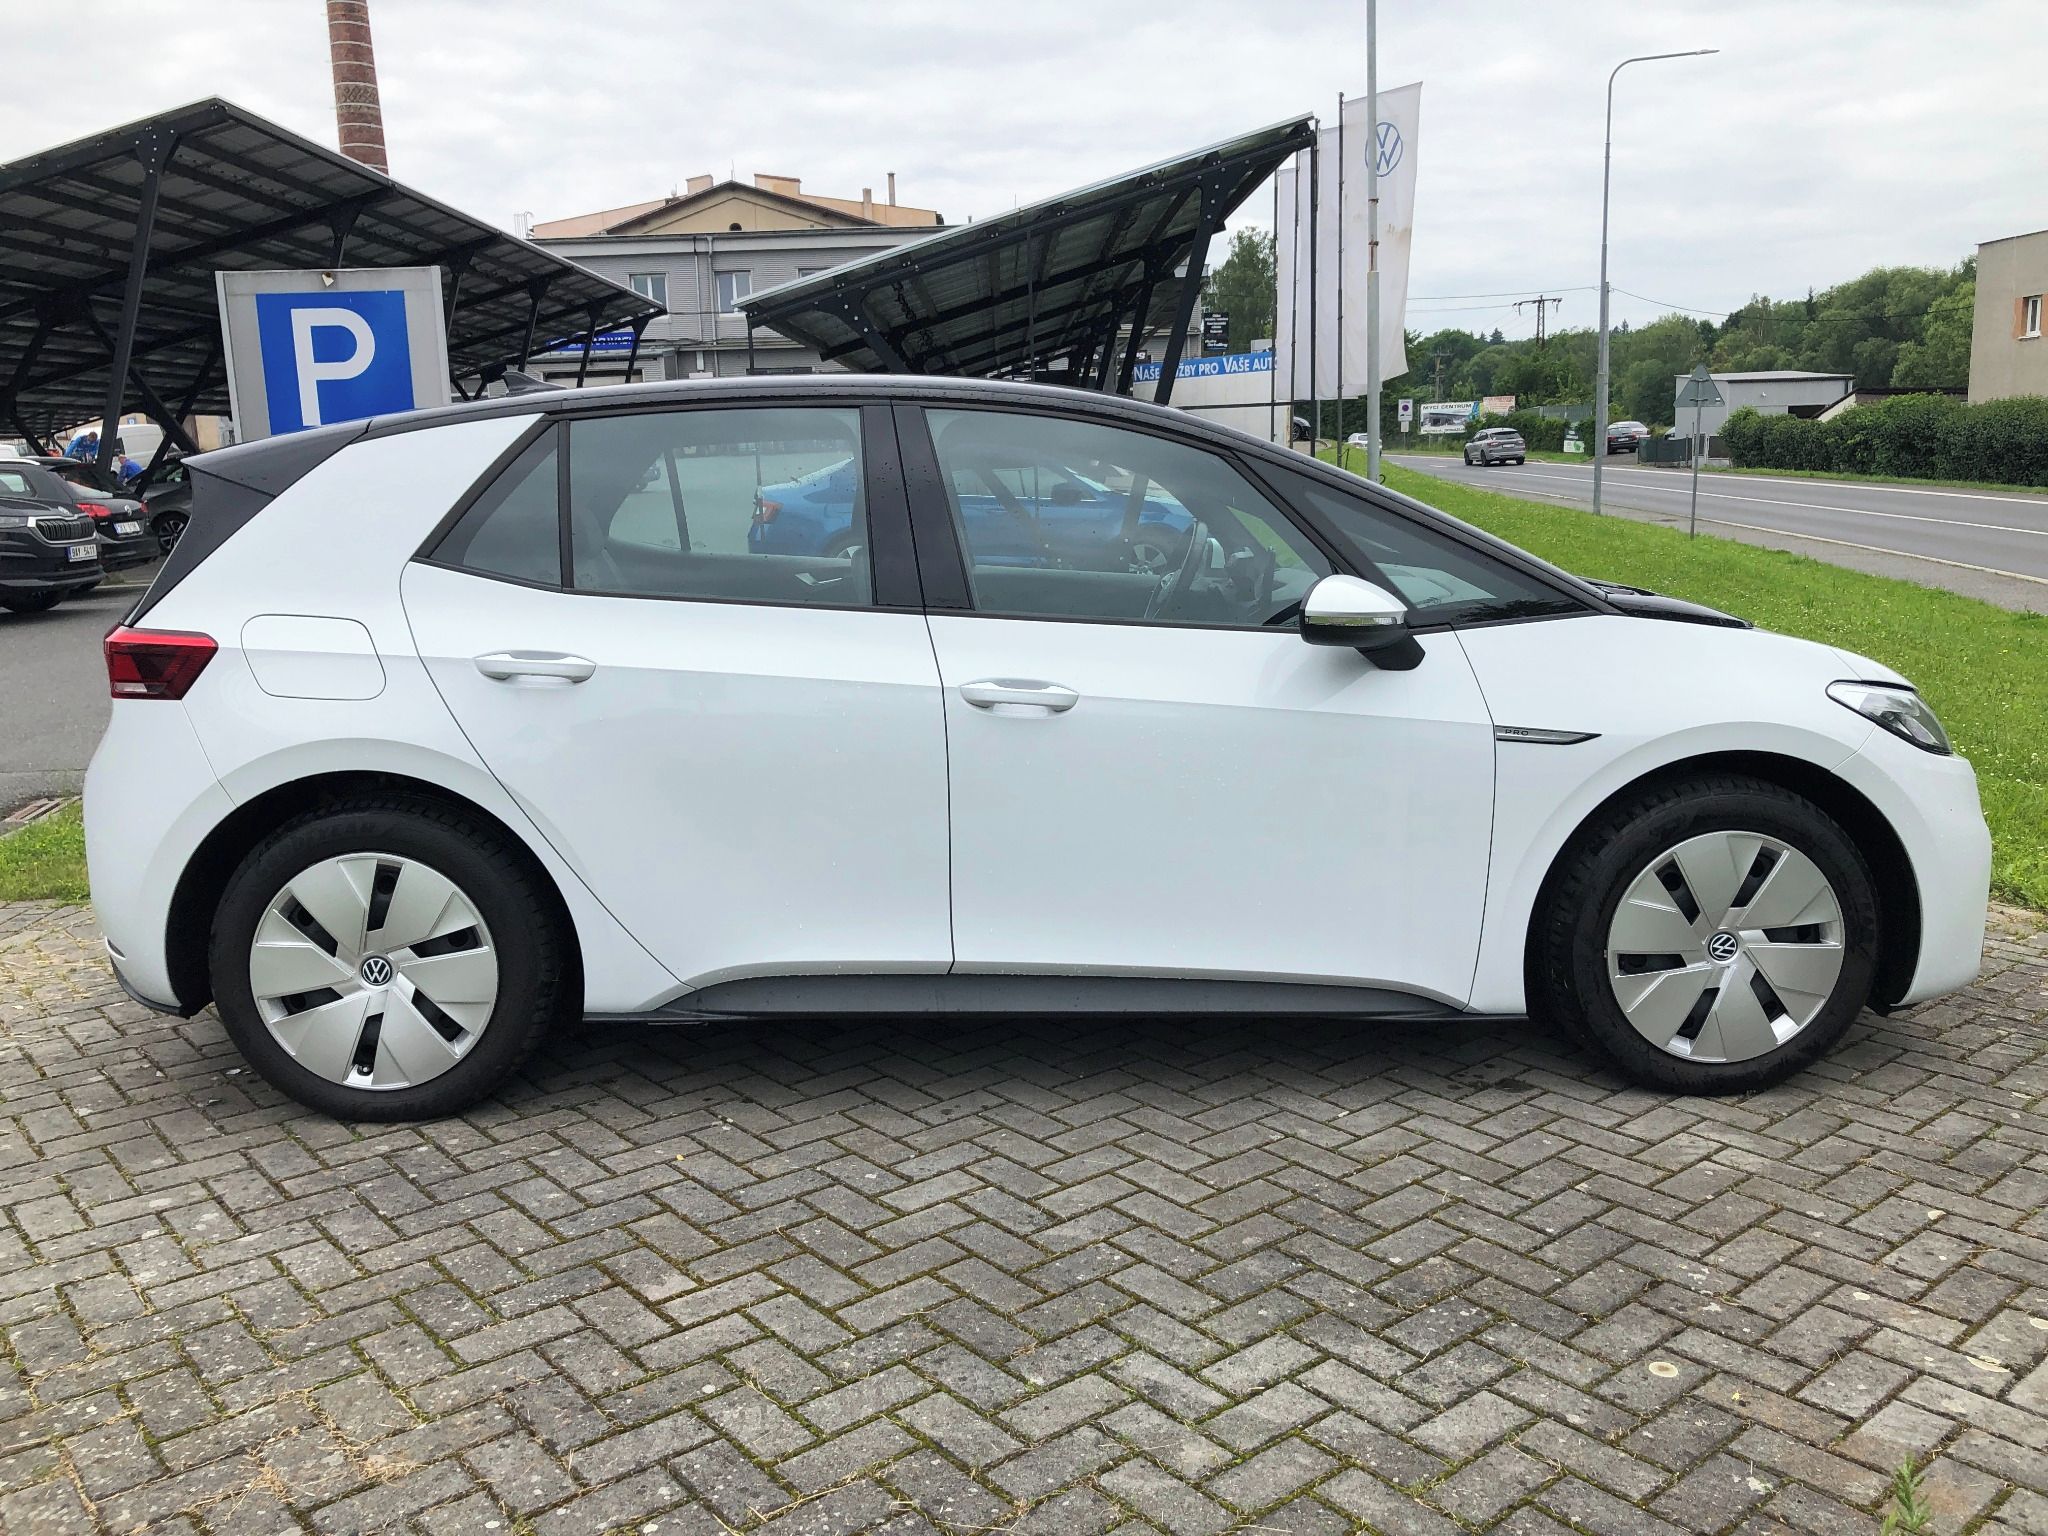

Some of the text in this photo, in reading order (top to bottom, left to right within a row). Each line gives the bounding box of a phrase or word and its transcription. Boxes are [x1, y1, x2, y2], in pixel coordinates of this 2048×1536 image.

[290, 307, 376, 427] P
[1133, 365, 1160, 381] NAŠE
[1198, 362, 1219, 376] PRO
[1222, 356, 1250, 373] VAŠE
[1505, 728, 1529, 736] PRO
[362, 958, 391, 985] VW
